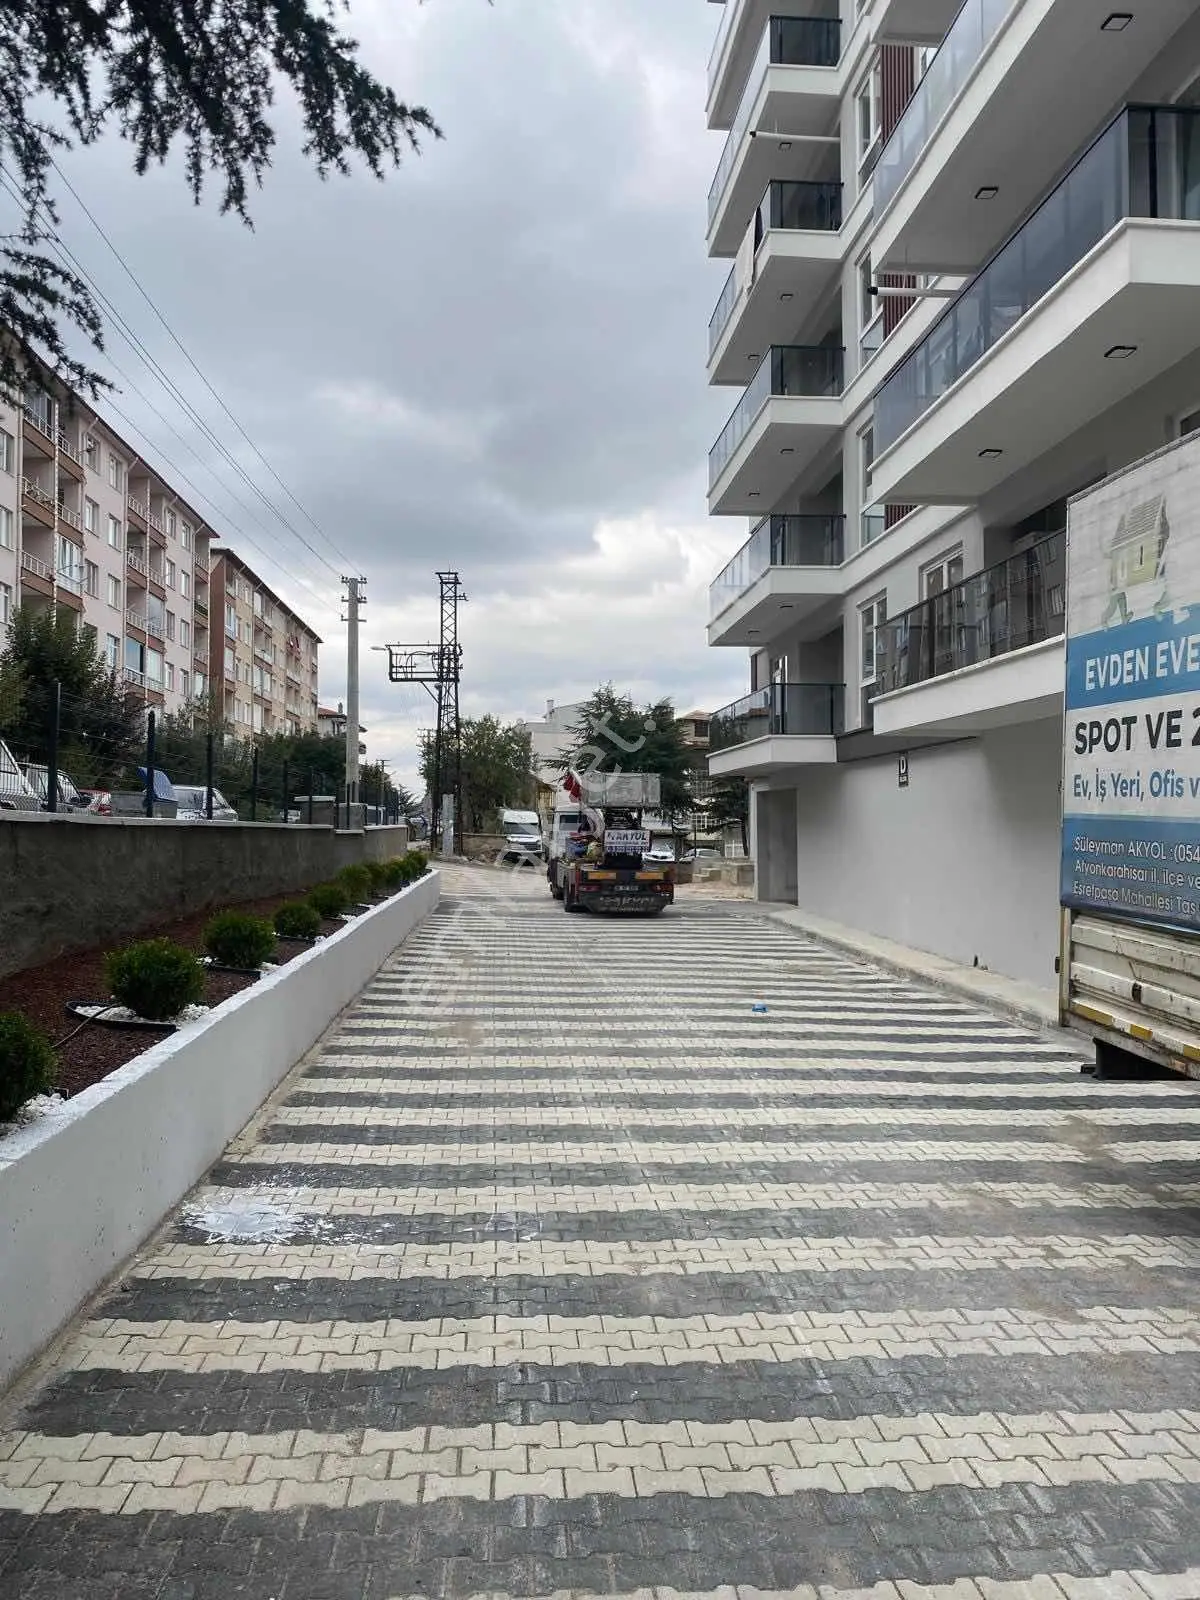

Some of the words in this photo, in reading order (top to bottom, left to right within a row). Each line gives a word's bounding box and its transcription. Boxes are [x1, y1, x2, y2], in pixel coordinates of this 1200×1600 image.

[1085, 646, 1149, 691] EVDEN
[1156, 634, 1200, 678] EVE
[1074, 716, 1138, 755] SPOT
[1145, 709, 1182, 749] VE
[1073, 774, 1092, 800] Ev,
[1111, 770, 1144, 802] Yeri,
[1150, 769, 1184, 798] Ofis
[1074, 836, 1125, 857] Süleyman
[1127, 841, 1167, 860] AKYOL
